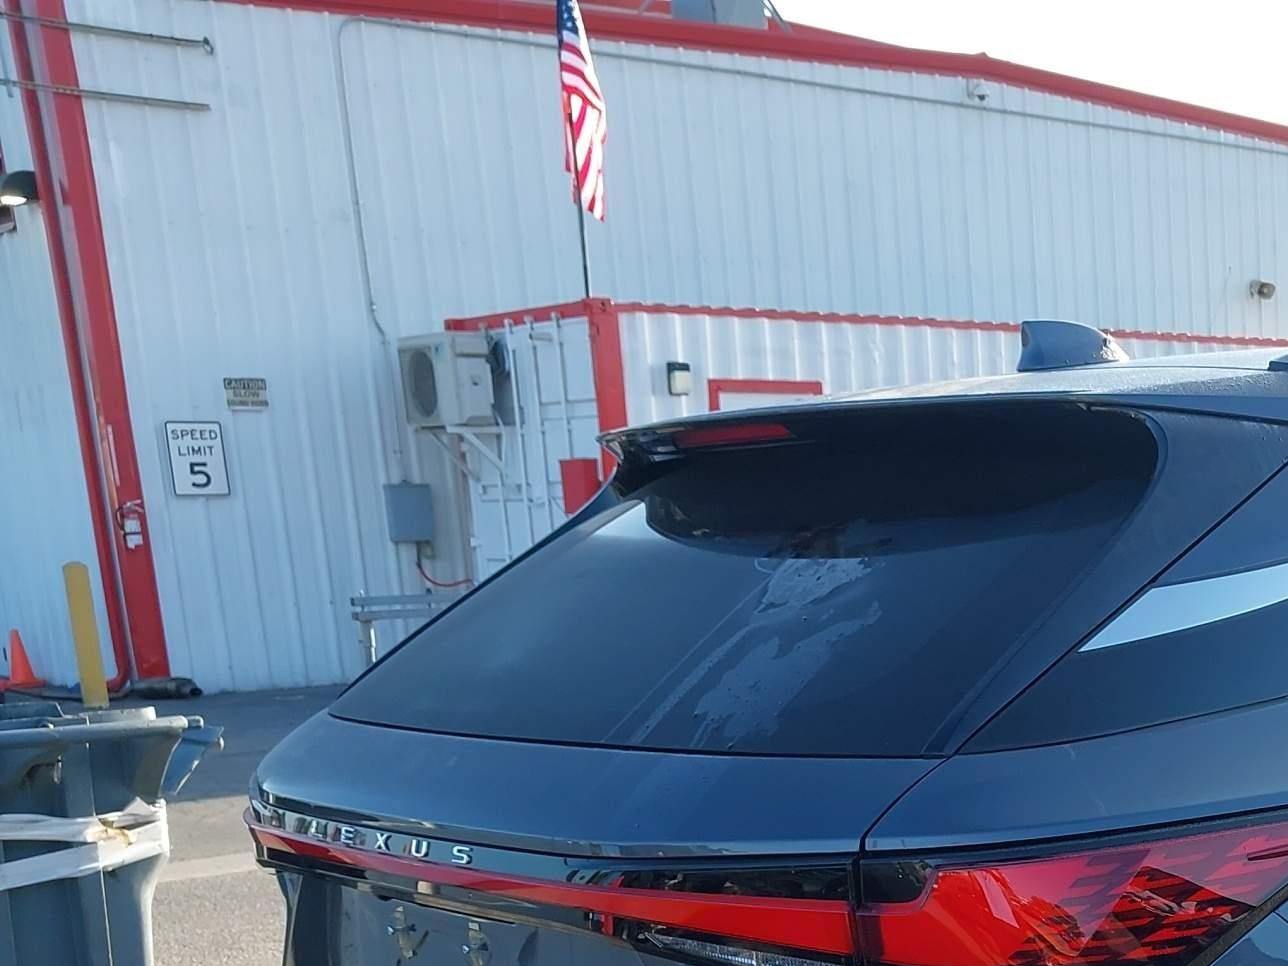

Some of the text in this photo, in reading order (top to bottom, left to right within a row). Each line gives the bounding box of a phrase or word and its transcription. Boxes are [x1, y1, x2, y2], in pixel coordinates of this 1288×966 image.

[225, 379, 266, 390] CAUTION
[232, 390, 260, 398] SLOW
[170, 429, 218, 441] SPEED
[177, 445, 215, 457] LIMIT
[189, 462, 212, 488] 5
[309, 820, 474, 865] LEXUS
